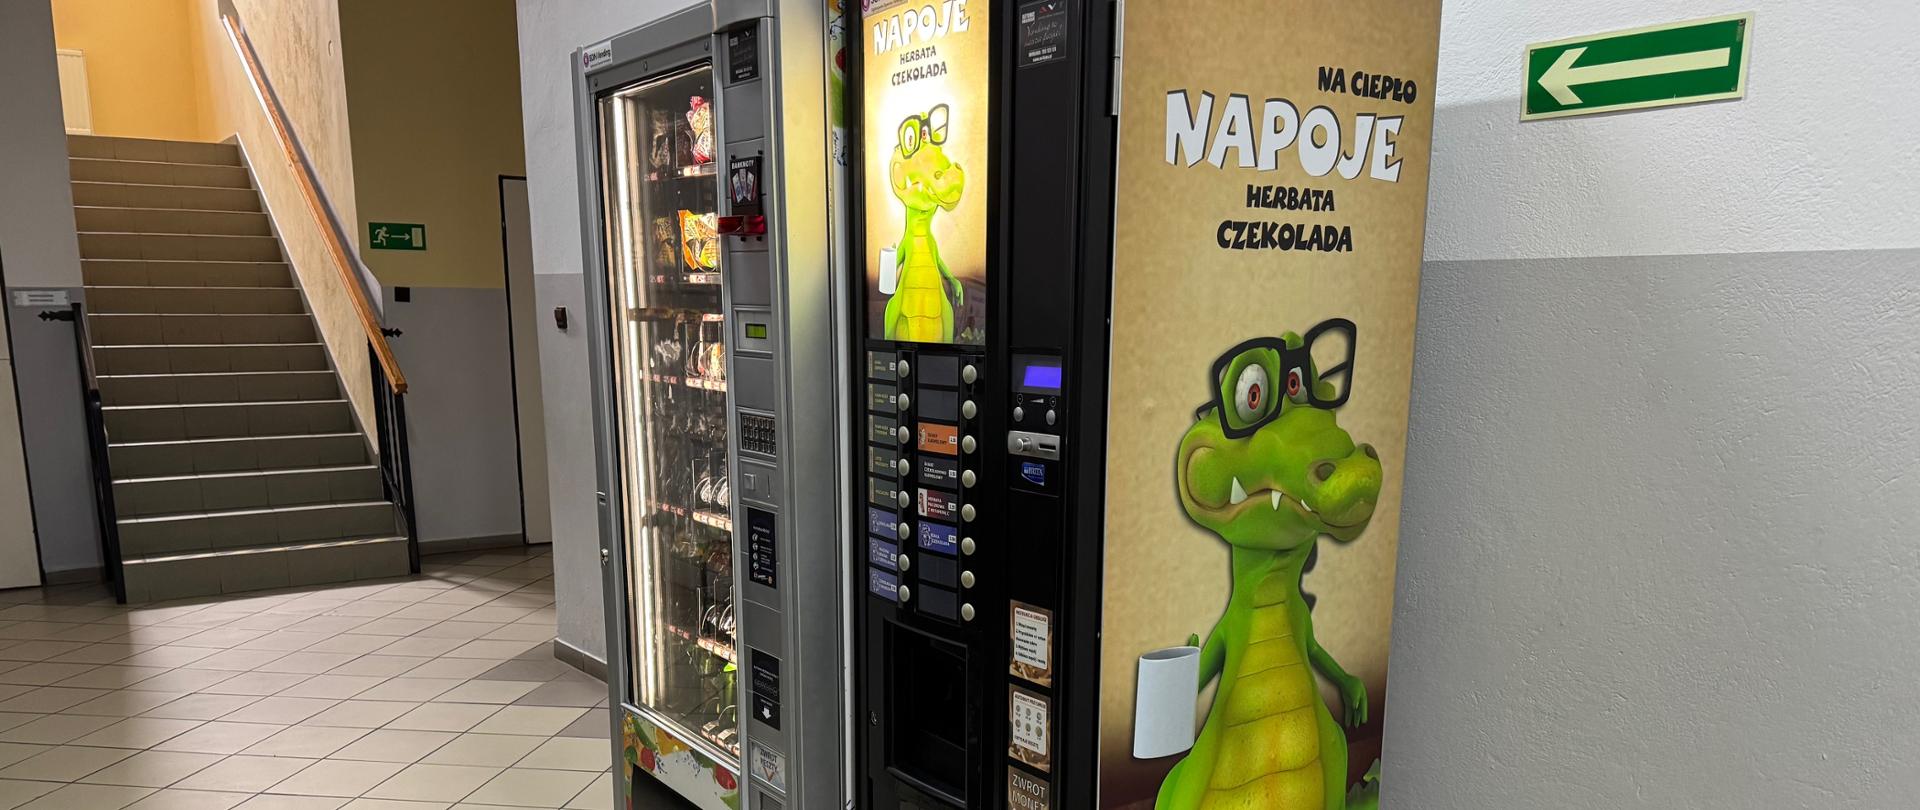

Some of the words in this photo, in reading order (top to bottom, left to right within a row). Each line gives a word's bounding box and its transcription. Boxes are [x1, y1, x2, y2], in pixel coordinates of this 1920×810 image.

[873, 0, 970, 55] NAPOJE
[900, 45, 937, 65] HERBATA
[891, 61, 947, 86] CZEKOLADA
[1318, 66, 1346, 93] NA
[1350, 71, 1417, 104] CIEPŁO
[1165, 89, 1405, 183] NAPOJE
[731, 159, 754, 170] BANKNOTY
[1246, 184, 1335, 212] HERBATA
[1216, 220, 1353, 252] CZEKOLADA
[1012, 774, 1045, 798] ZWROT
